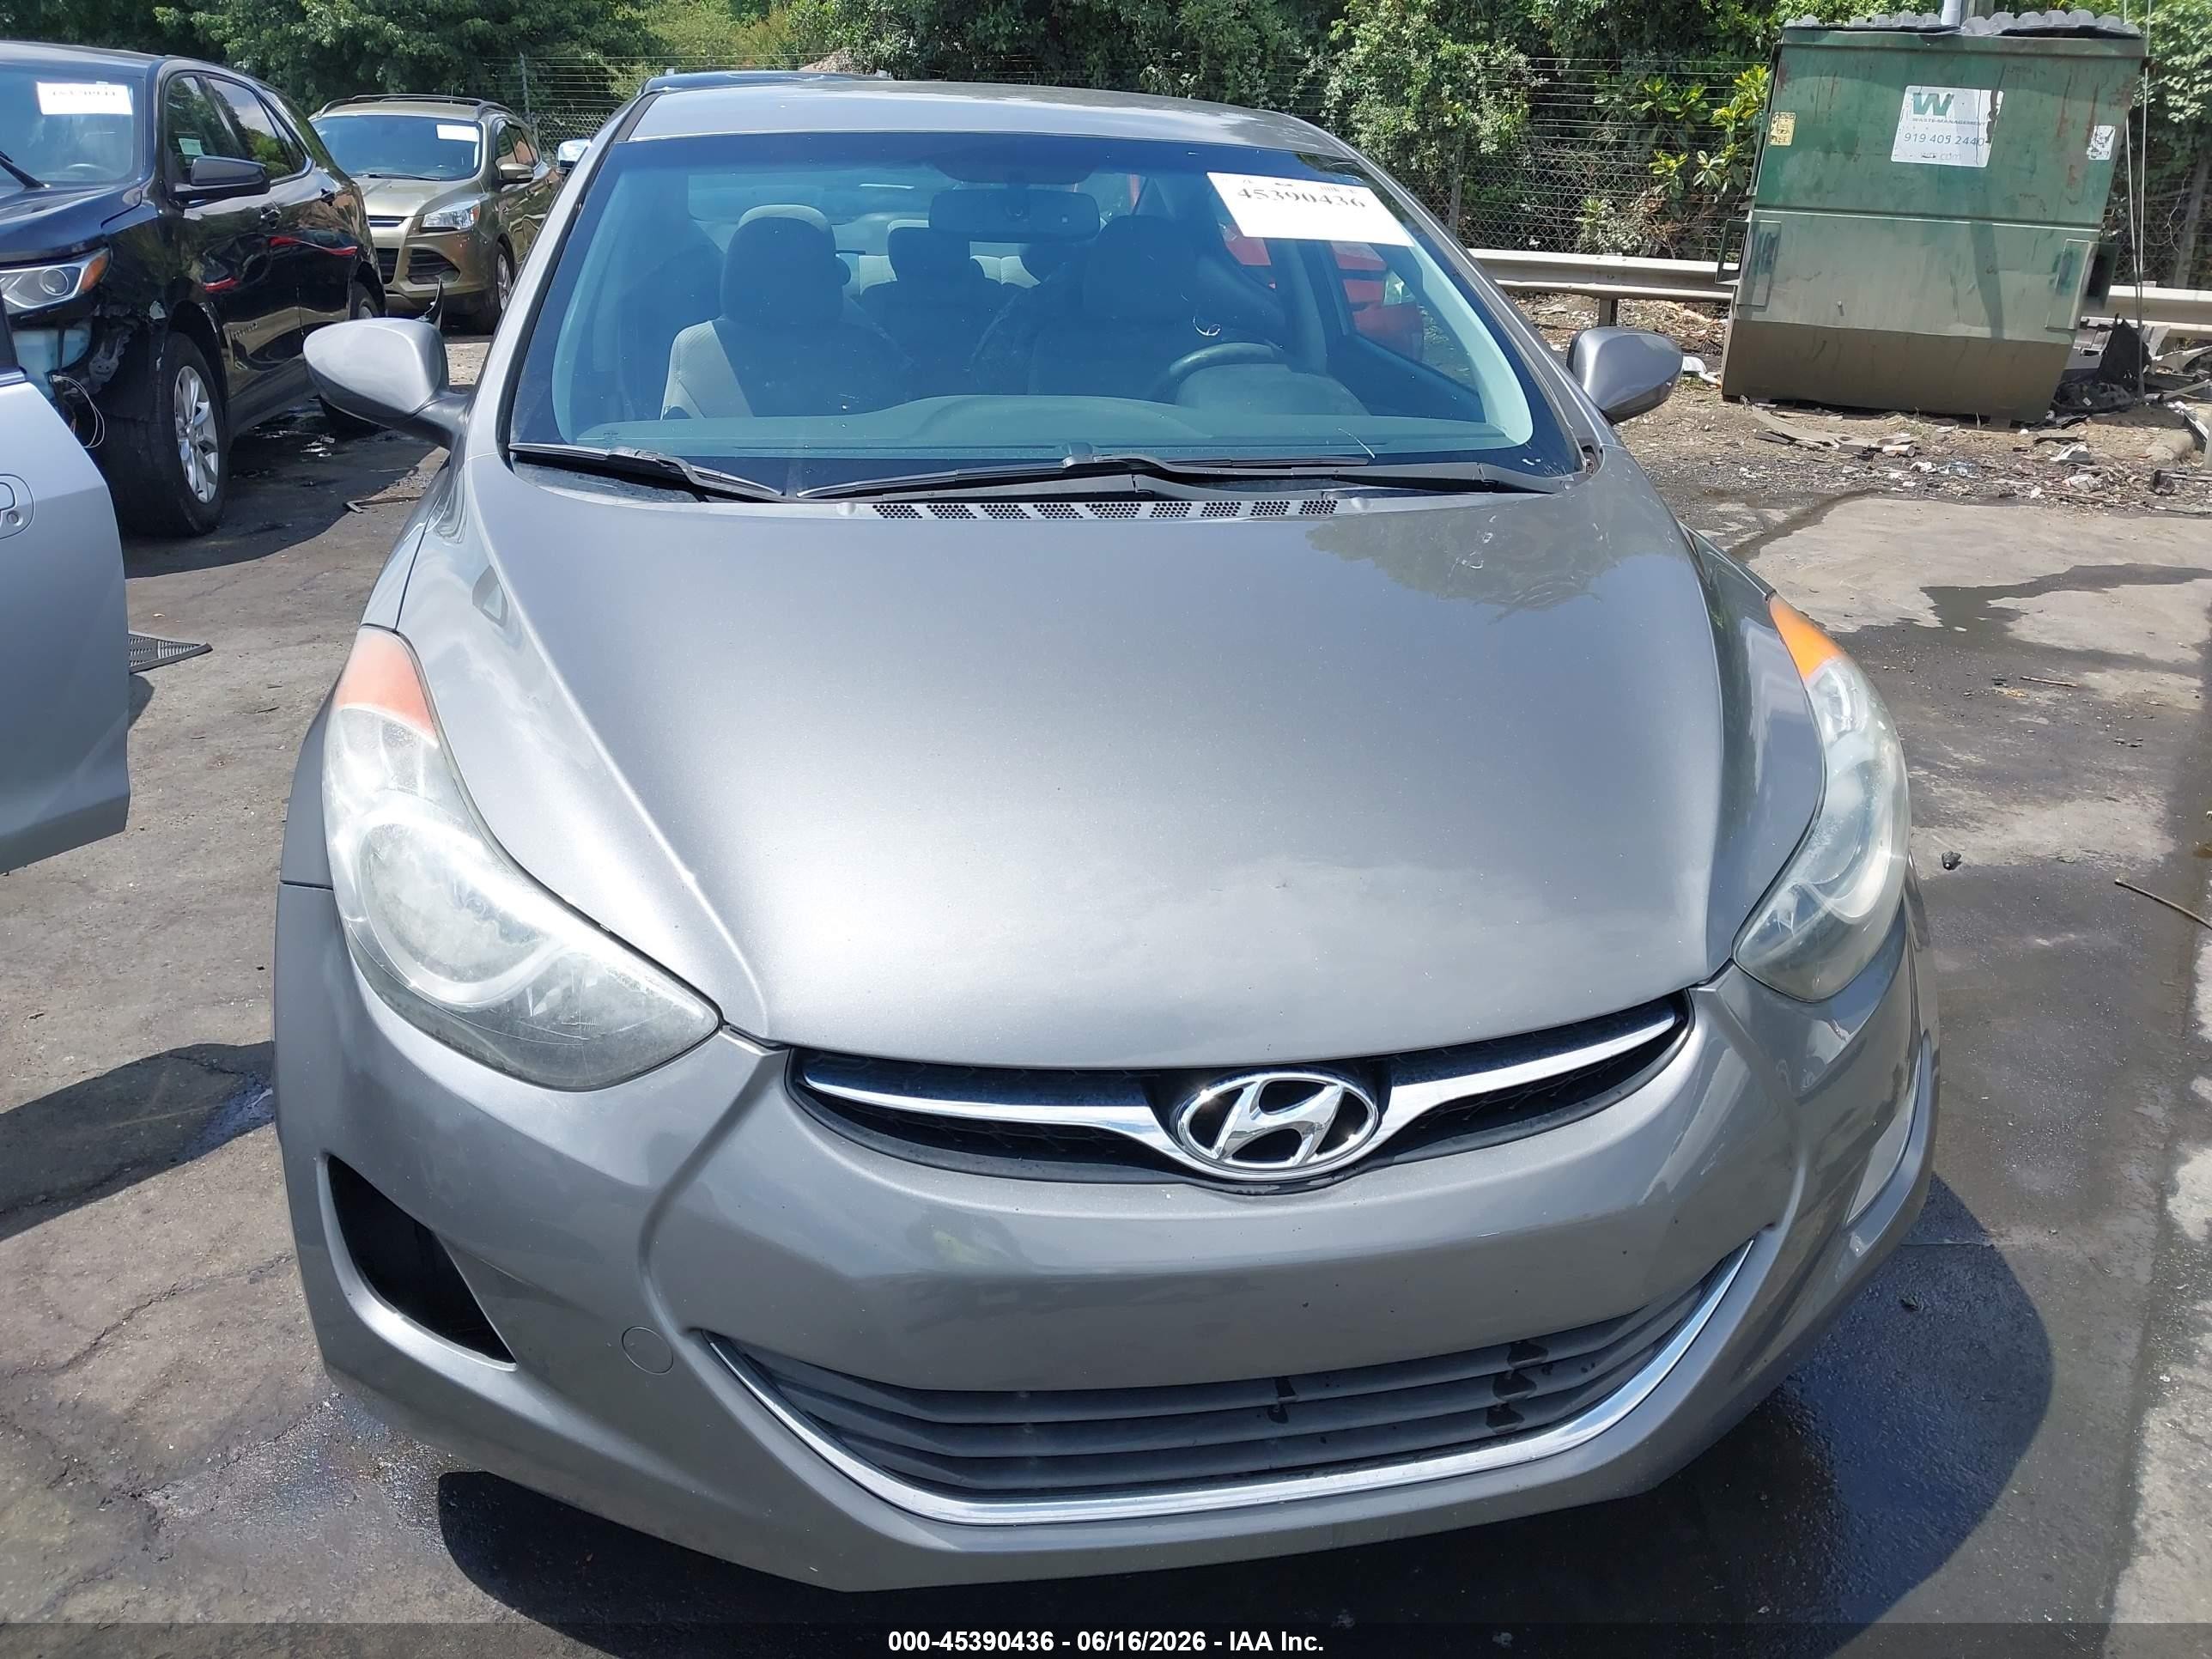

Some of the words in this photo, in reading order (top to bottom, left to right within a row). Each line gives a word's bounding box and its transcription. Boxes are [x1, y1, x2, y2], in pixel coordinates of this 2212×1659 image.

[1904, 132, 1926, 143] 919
[1954, 136, 1985, 146] 2440
[1237, 187, 1366, 209] 45390436
